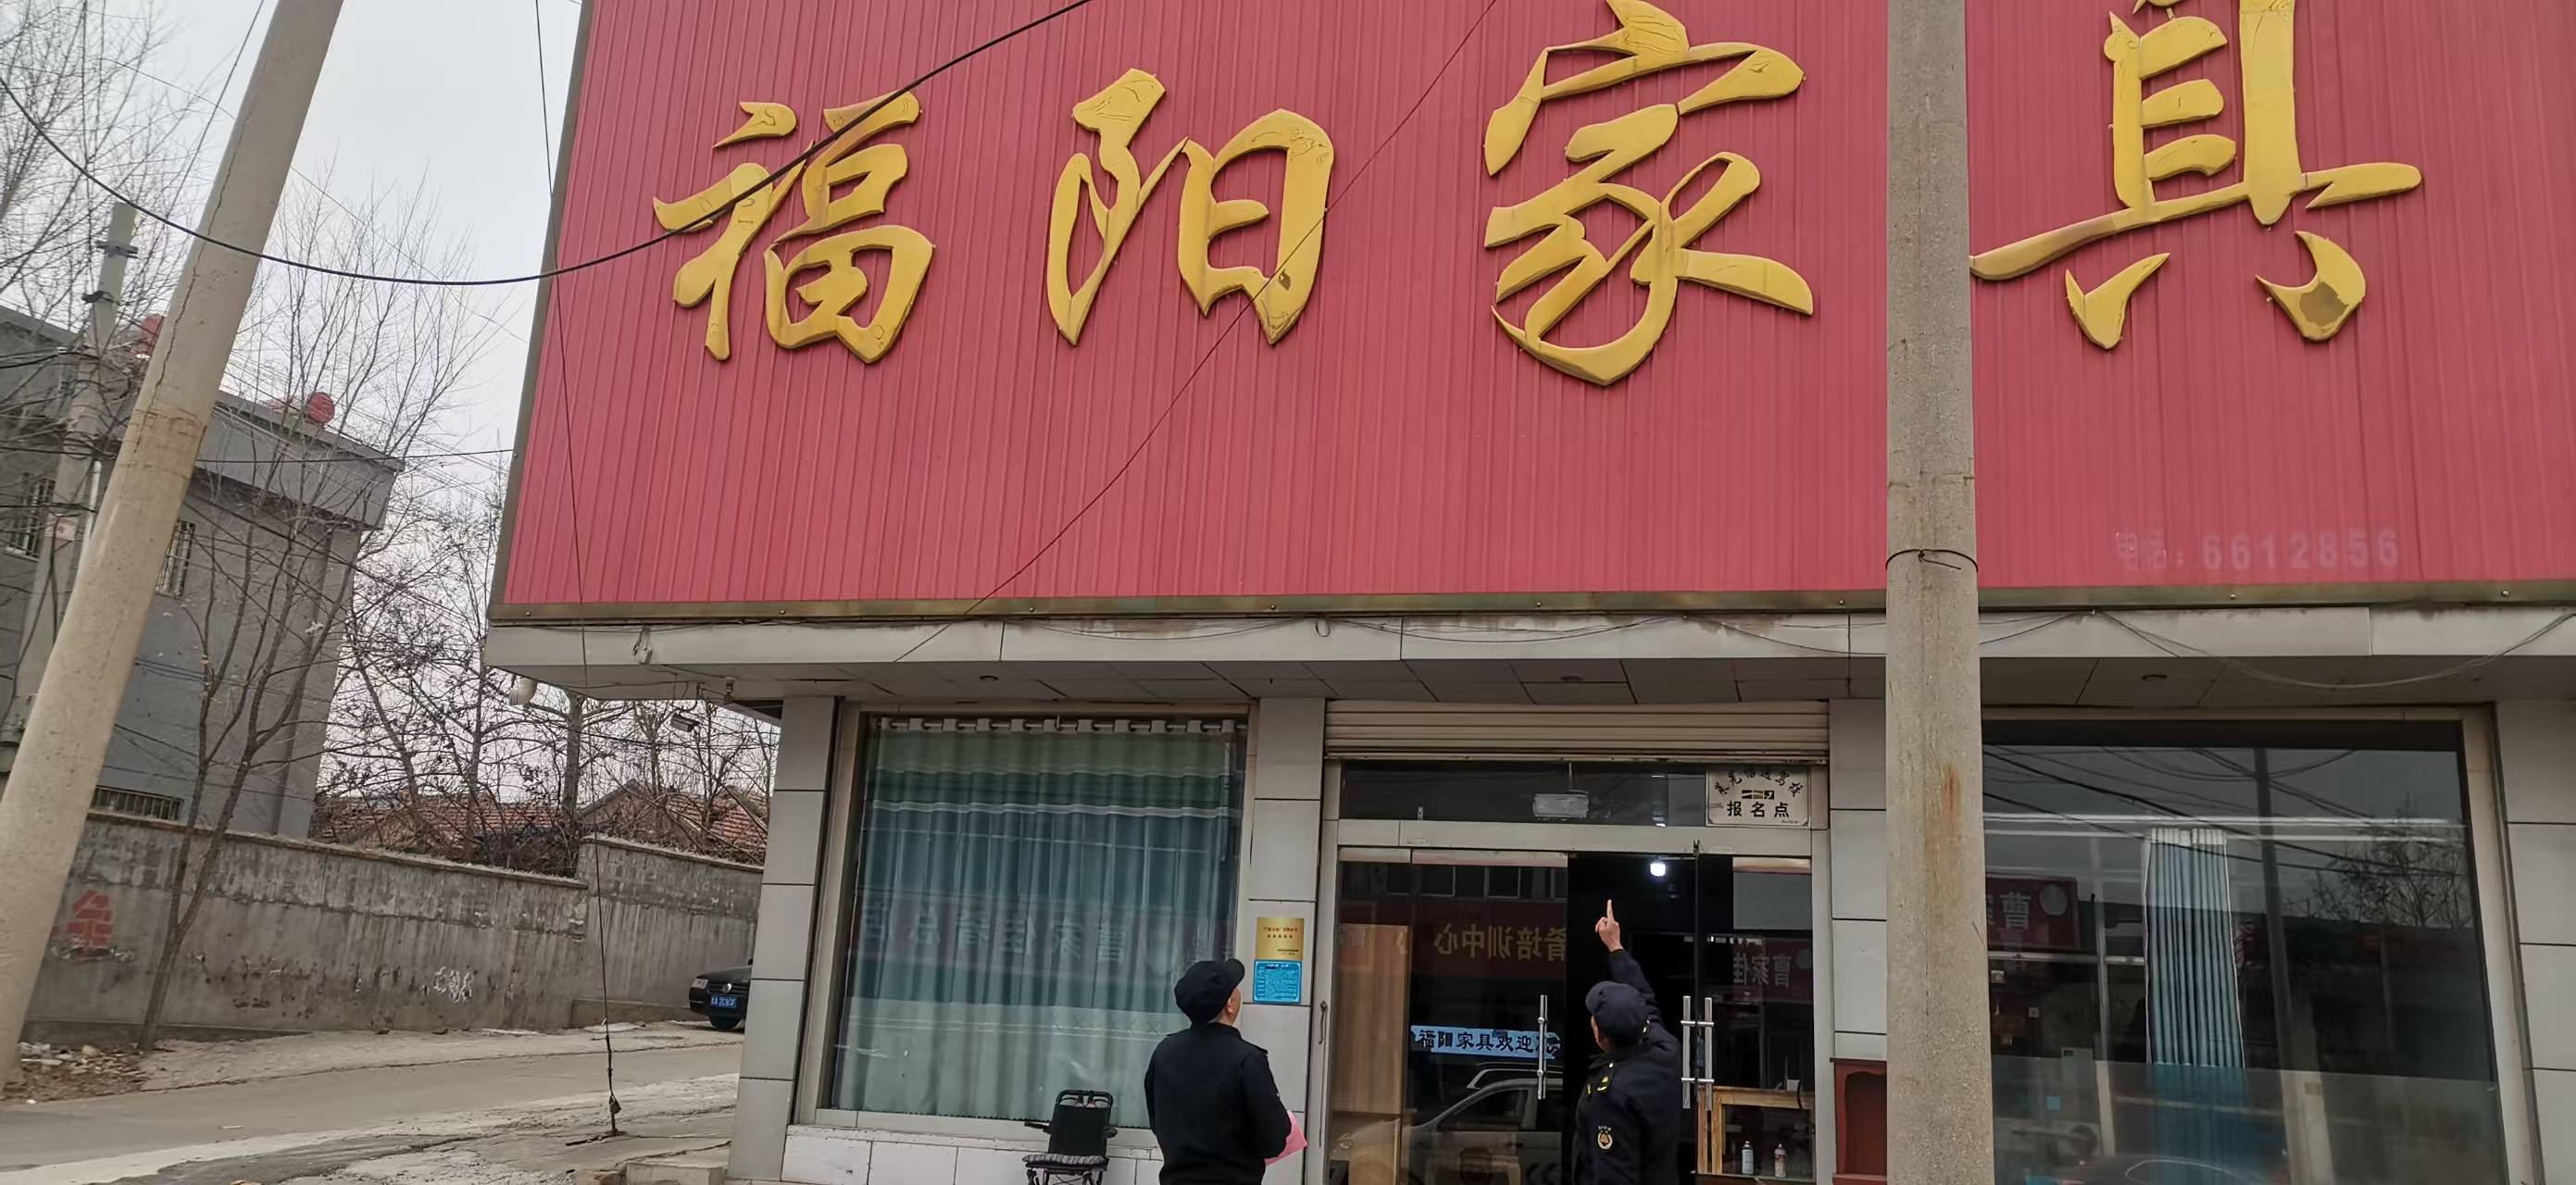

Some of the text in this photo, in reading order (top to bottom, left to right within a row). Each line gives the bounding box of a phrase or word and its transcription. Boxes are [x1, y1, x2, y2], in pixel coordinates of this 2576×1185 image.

[653, 0, 2422, 385] 福阳家具
[1727, 801, 1790, 817] 报名点
